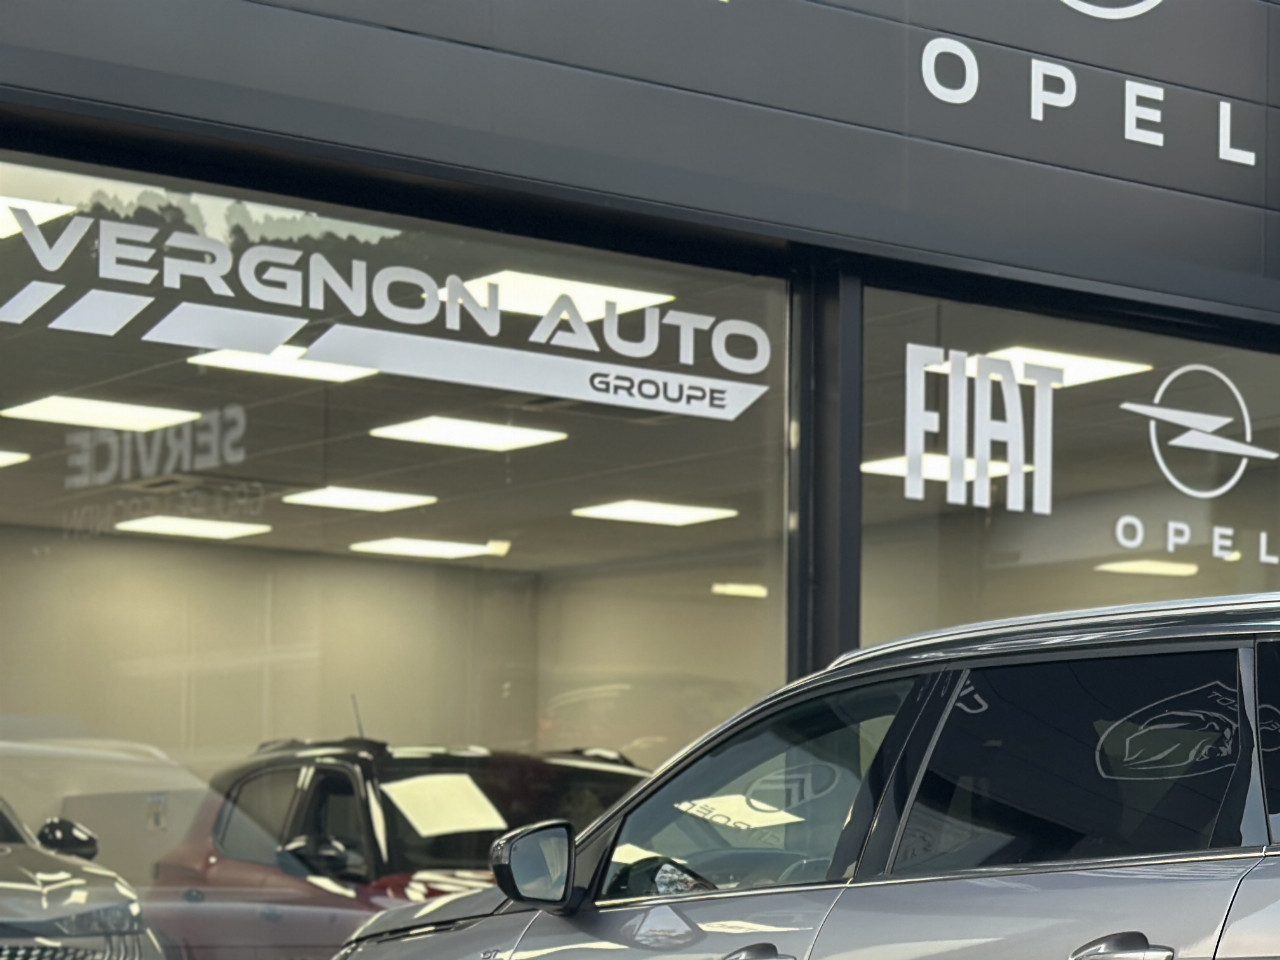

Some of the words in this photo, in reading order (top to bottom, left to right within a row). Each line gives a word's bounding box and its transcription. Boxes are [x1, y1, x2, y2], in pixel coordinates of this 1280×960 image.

[921, 37, 1256, 166] OPEL
[7, 207, 500, 337] VERGNON
[528, 293, 772, 375] AUTO
[588, 373, 728, 410] GROUPE
[904, 343, 1065, 515] FIAT
[1115, 515, 1280, 565] OPEL
